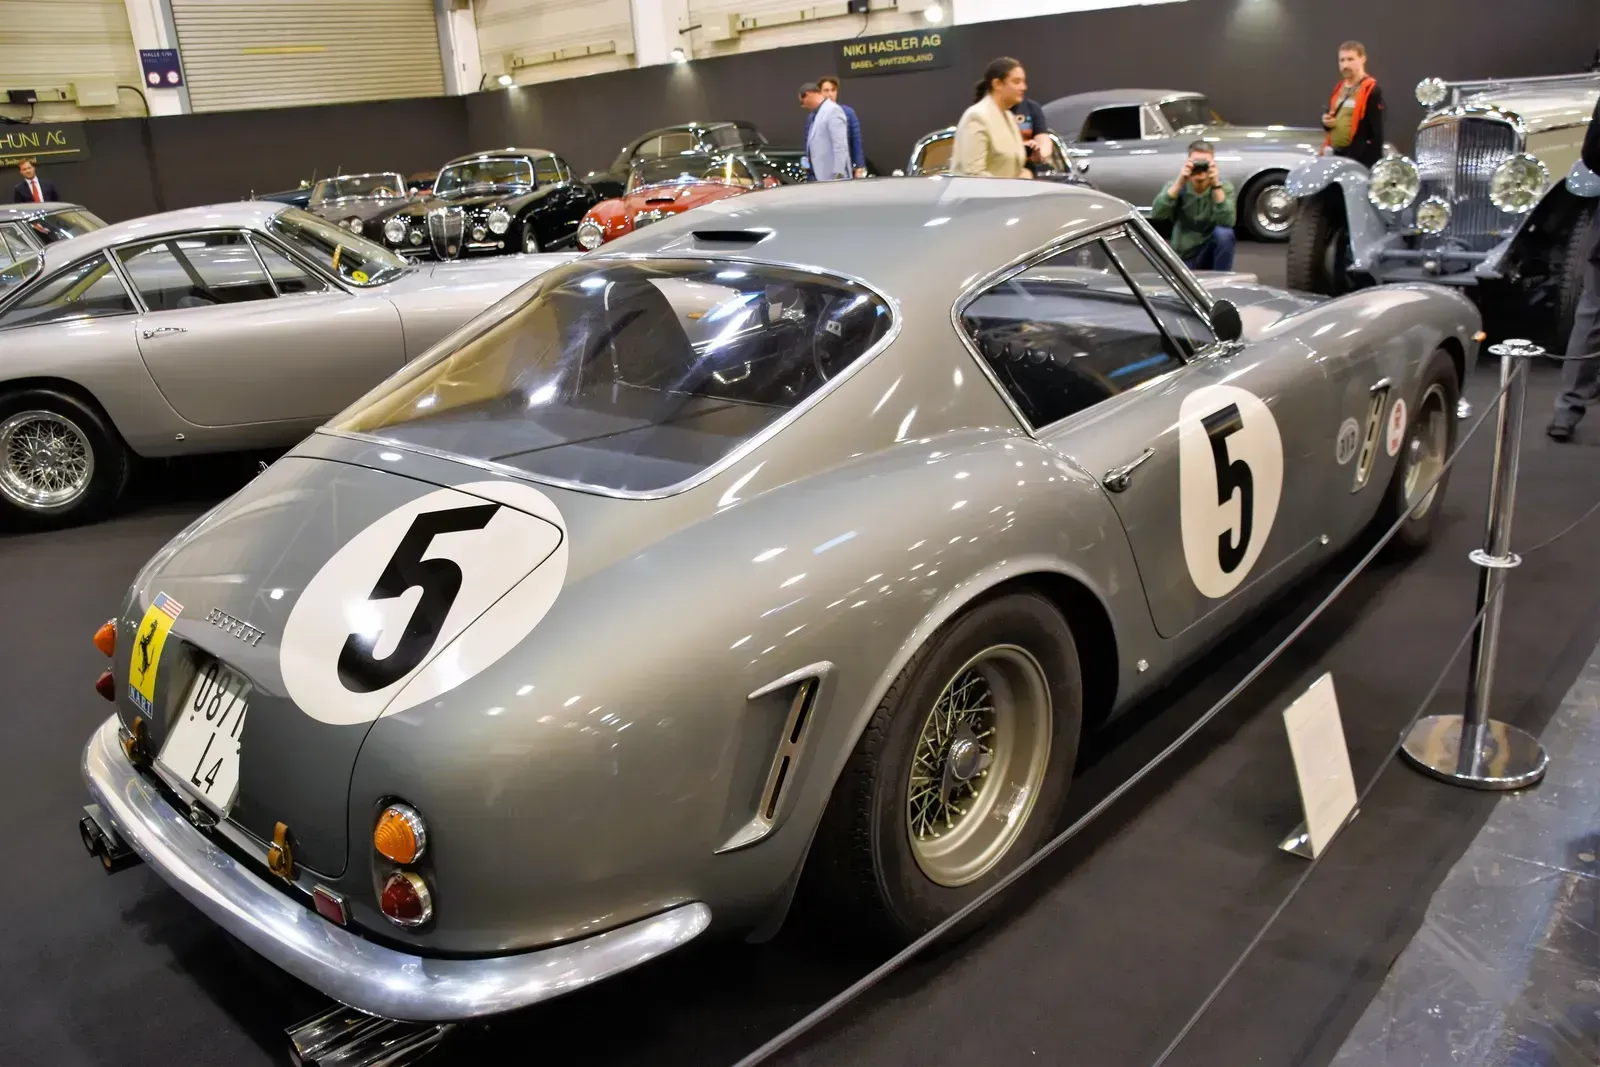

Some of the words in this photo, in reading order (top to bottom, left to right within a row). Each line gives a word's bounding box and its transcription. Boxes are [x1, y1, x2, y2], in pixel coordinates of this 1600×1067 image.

[843, 45, 867, 57] NIKI
[868, 37, 919, 54] HASLER
[921, 34, 942, 48] AG
[46, 130, 67, 146] AG
[1200, 402, 1254, 574] 5
[337, 503, 502, 694] 5
